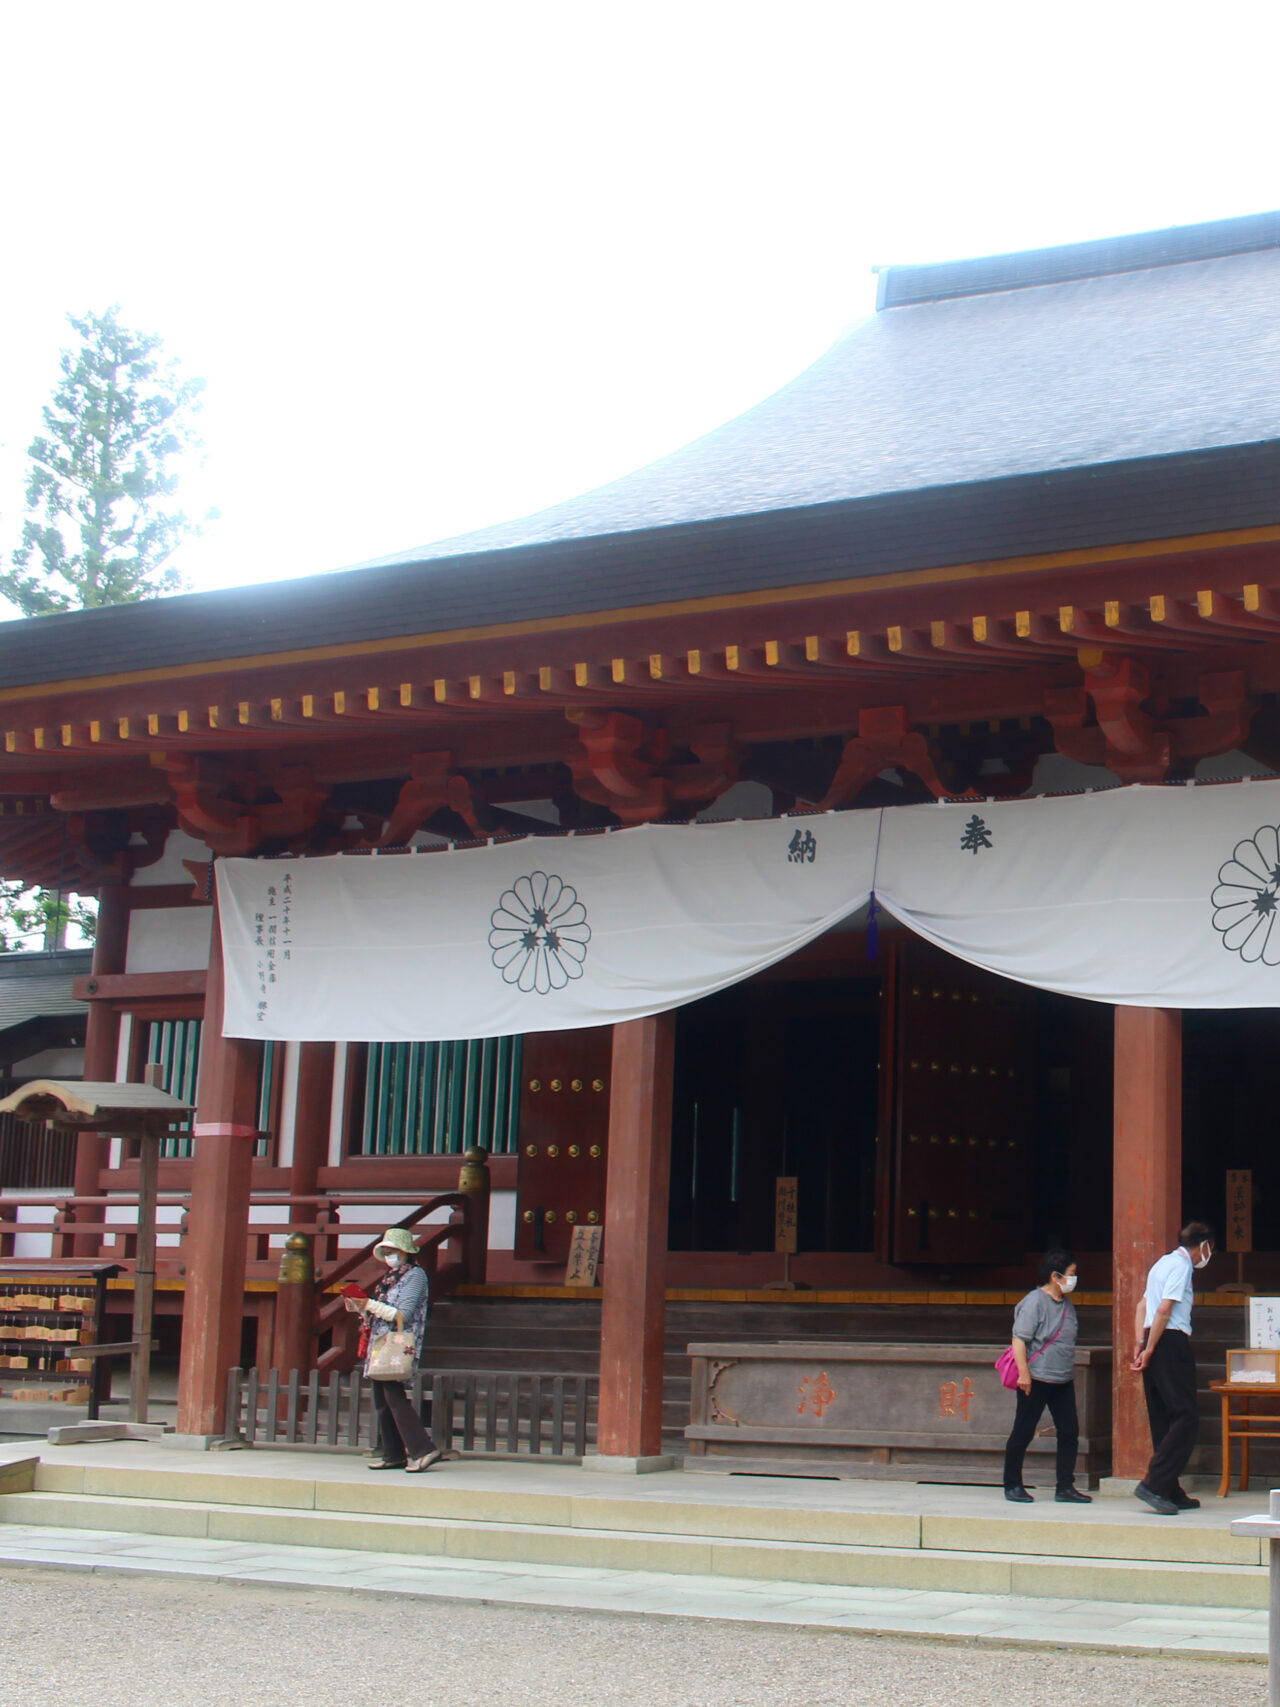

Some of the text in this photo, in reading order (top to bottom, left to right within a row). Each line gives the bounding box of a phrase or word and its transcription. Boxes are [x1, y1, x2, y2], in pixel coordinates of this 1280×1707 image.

[787, 829, 818, 864] 納
[961, 814, 993, 855] 奉
[797, 1372, 975, 1422] 浄 財
